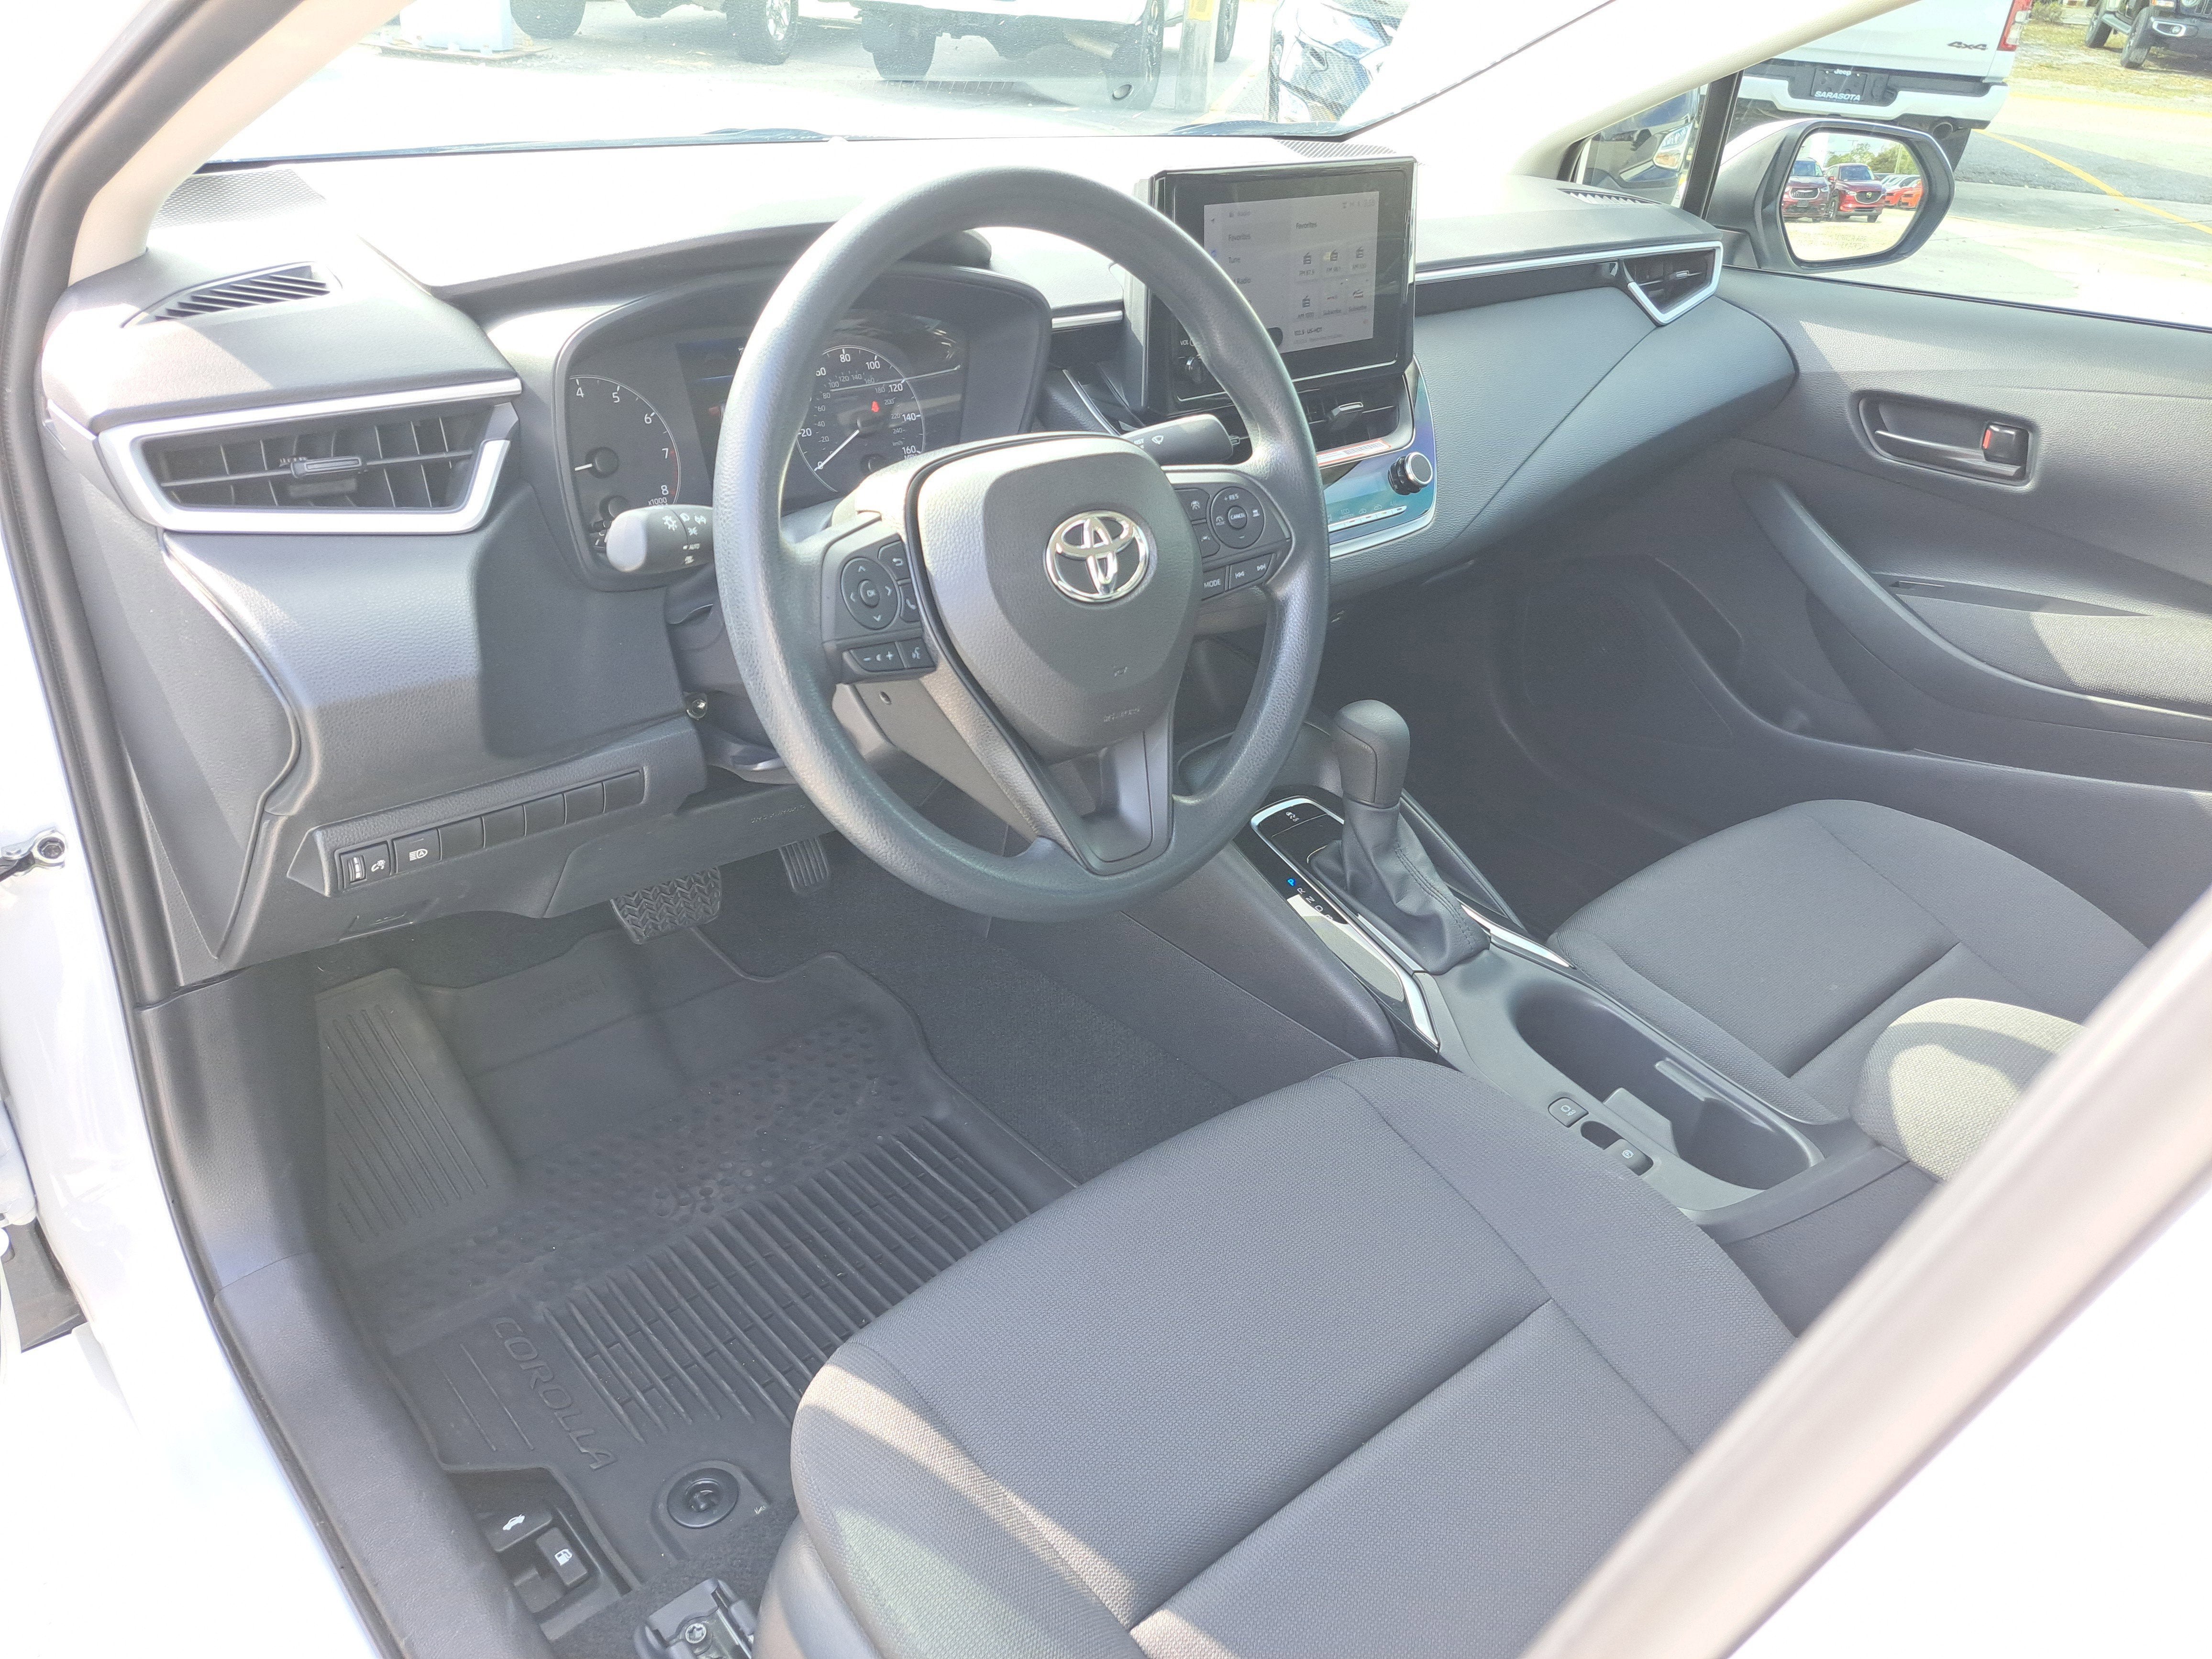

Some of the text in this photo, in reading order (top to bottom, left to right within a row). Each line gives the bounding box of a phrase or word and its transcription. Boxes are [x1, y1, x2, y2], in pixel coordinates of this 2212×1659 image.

[1947, 41, 1988, 51] 4x4
[1834, 68, 1852, 77] Jeep
[1814, 90, 1861, 101] SARASOTA
[840, 354, 851, 363] 80
[865, 361, 880, 370] 100
[576, 387, 584, 398] 4
[888, 383, 903, 392] 120
[612, 391, 620, 403] 5
[644, 413, 652, 424] 6
[902, 412, 917, 422] 140
[801, 428, 812, 437] 20
[662, 448, 668, 459] 7
[902, 445, 917, 454] 160
[661, 485, 668, 495] 8
[648, 497, 667, 506] x1000
[1230, 512, 1246, 520] CANCEL
[1204, 578, 1221, 588] MODE
[1287, 877, 1295, 886] P
[490, 1317, 618, 1471] COROLLA
